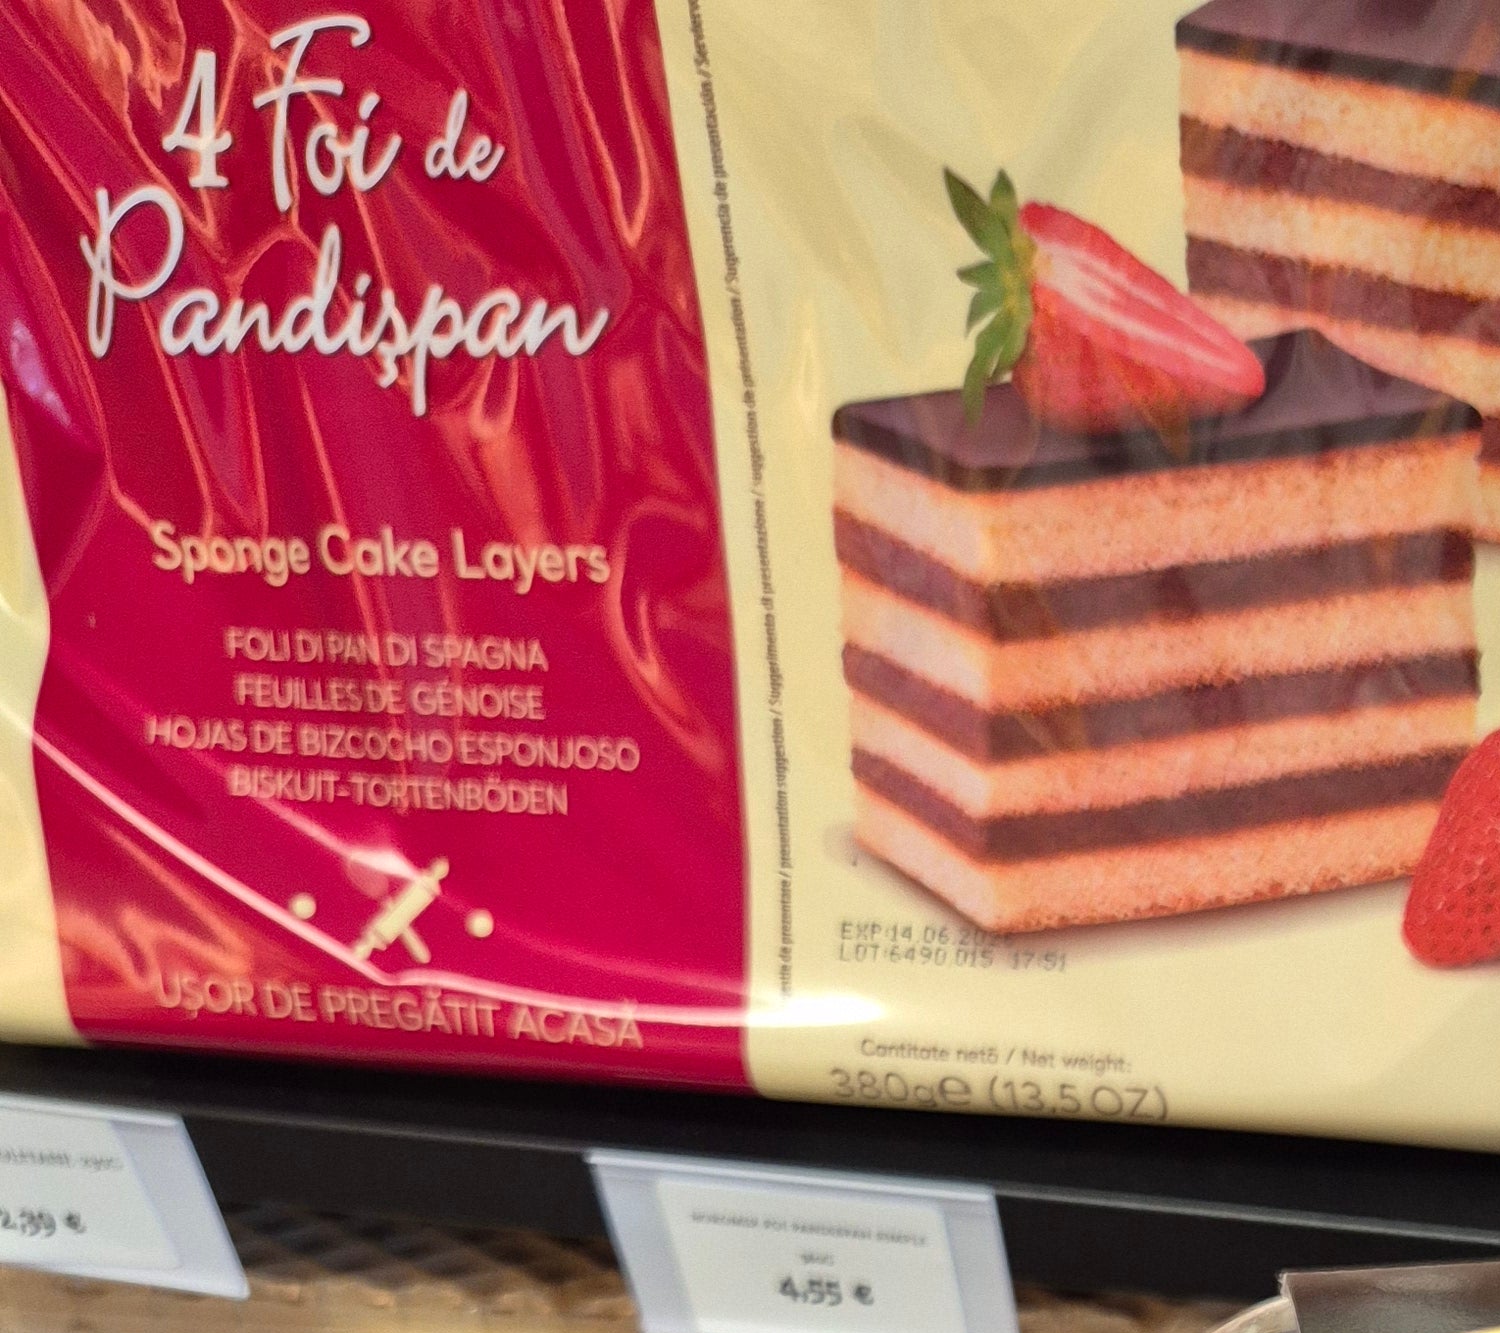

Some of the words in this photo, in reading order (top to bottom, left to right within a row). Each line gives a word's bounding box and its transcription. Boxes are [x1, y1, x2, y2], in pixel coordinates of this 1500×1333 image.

[162, 50, 231, 188] 4
[253, 14, 401, 213] Foi
[425, 90, 504, 182] de
[152, 522, 310, 586] Sponge
[319, 525, 438, 580] Cake
[454, 528, 610, 594] Layers
[293, 629, 326, 664] DI
[328, 630, 380, 666] PAN
[392, 631, 418, 667] DI
[425, 633, 549, 671] SPAGNA
[235, 675, 366, 711] FEUILLES
[367, 679, 405, 714] DE
[412, 680, 546, 719] GÉNOISE
[146, 718, 246, 753] HOJAS
[251, 723, 292, 755] DE
[302, 726, 455, 763] BIZCOCHO
[459, 732, 640, 772] ESPONJOSO
[229, 766, 569, 815] BISKUIT-TORTENBÖDEN
[263, 981, 318, 1024] DE
[861, 1038, 948, 1062] Cantitate
[1022, 1050, 1054, 1068] Net
[1063, 1053, 1131, 1076] weight:
